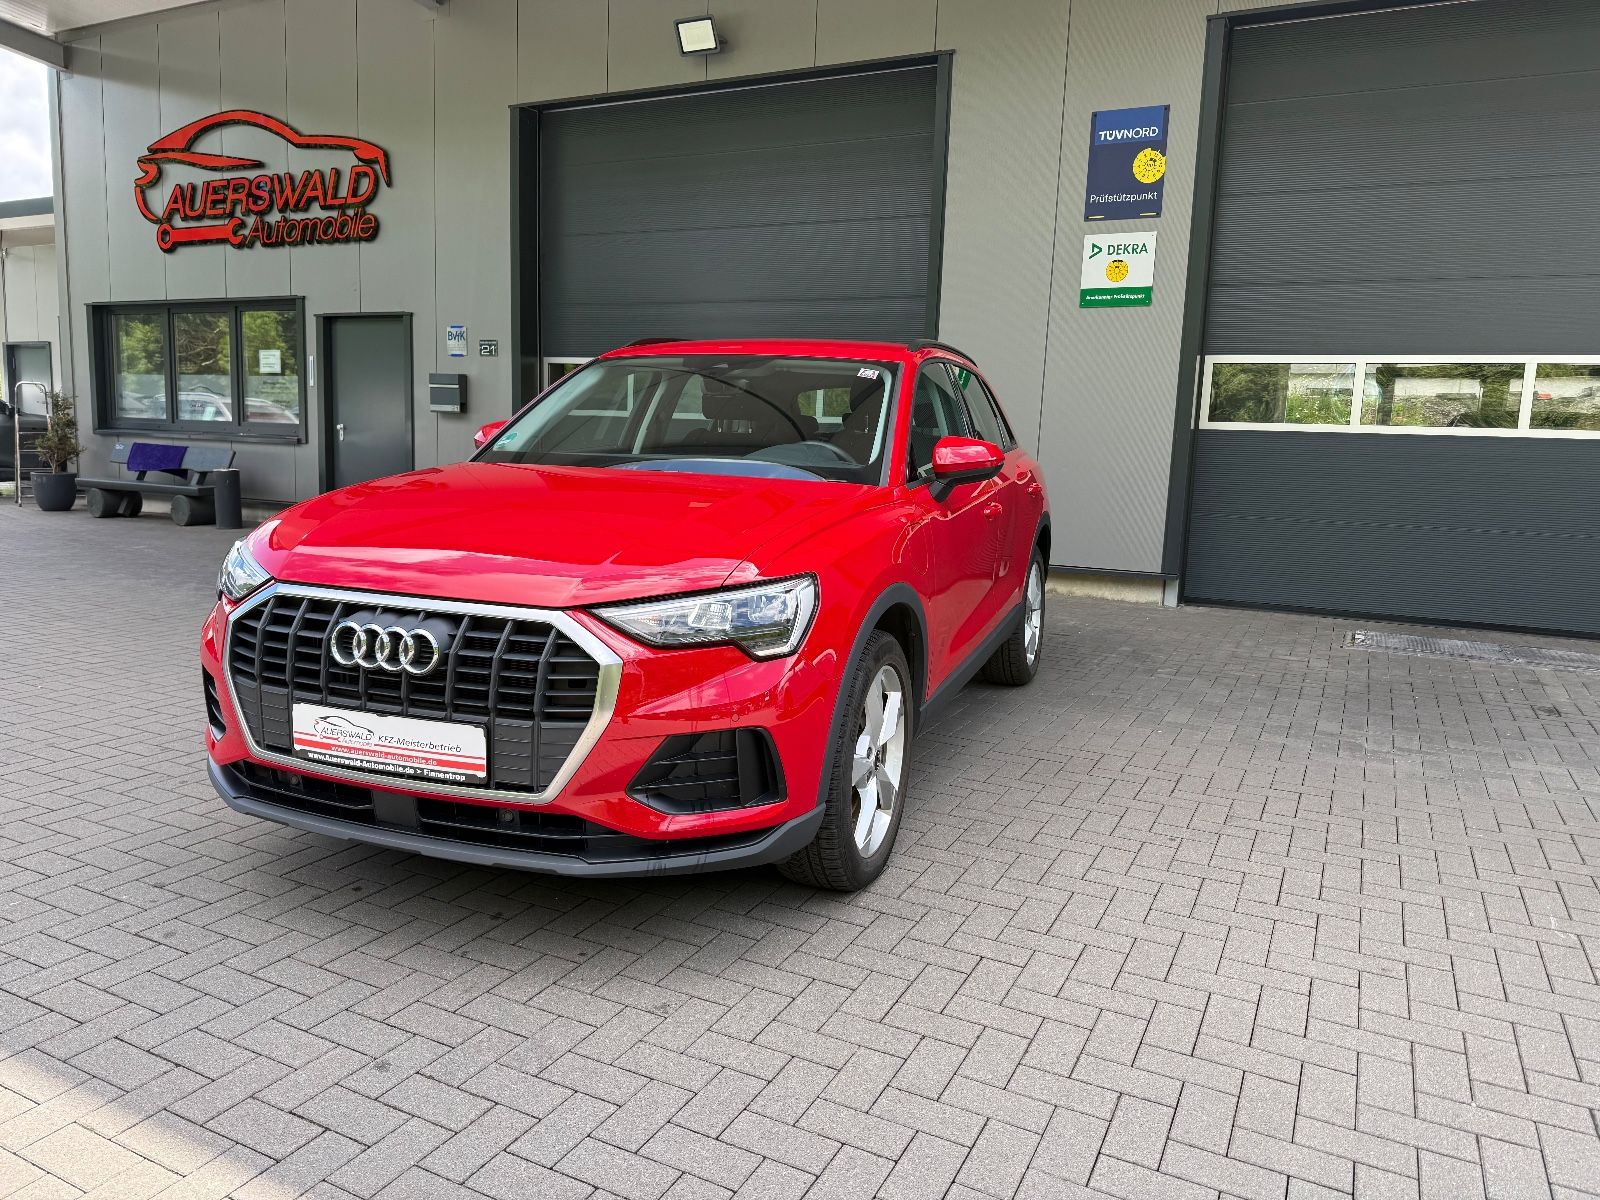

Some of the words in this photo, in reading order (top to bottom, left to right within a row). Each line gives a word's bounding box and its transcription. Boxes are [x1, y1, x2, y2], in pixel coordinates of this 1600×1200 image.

[162, 165, 376, 220] AUERSWALD
[1089, 191, 1158, 204] Prüfstützpunkt
[246, 207, 376, 246] Automobile
[1107, 242, 1149, 256] DEKRA
[481, 345, 495, 355] 21
[320, 726, 373, 741] AUERSWALD
[377, 735, 462, 753] KFZ-Meisterbetrieb
[330, 745, 438, 766] www.auerswald-automobile.de
[307, 752, 415, 774] www.Auerswald-Automobile.de
[423, 769, 466, 782] Finnentrop
